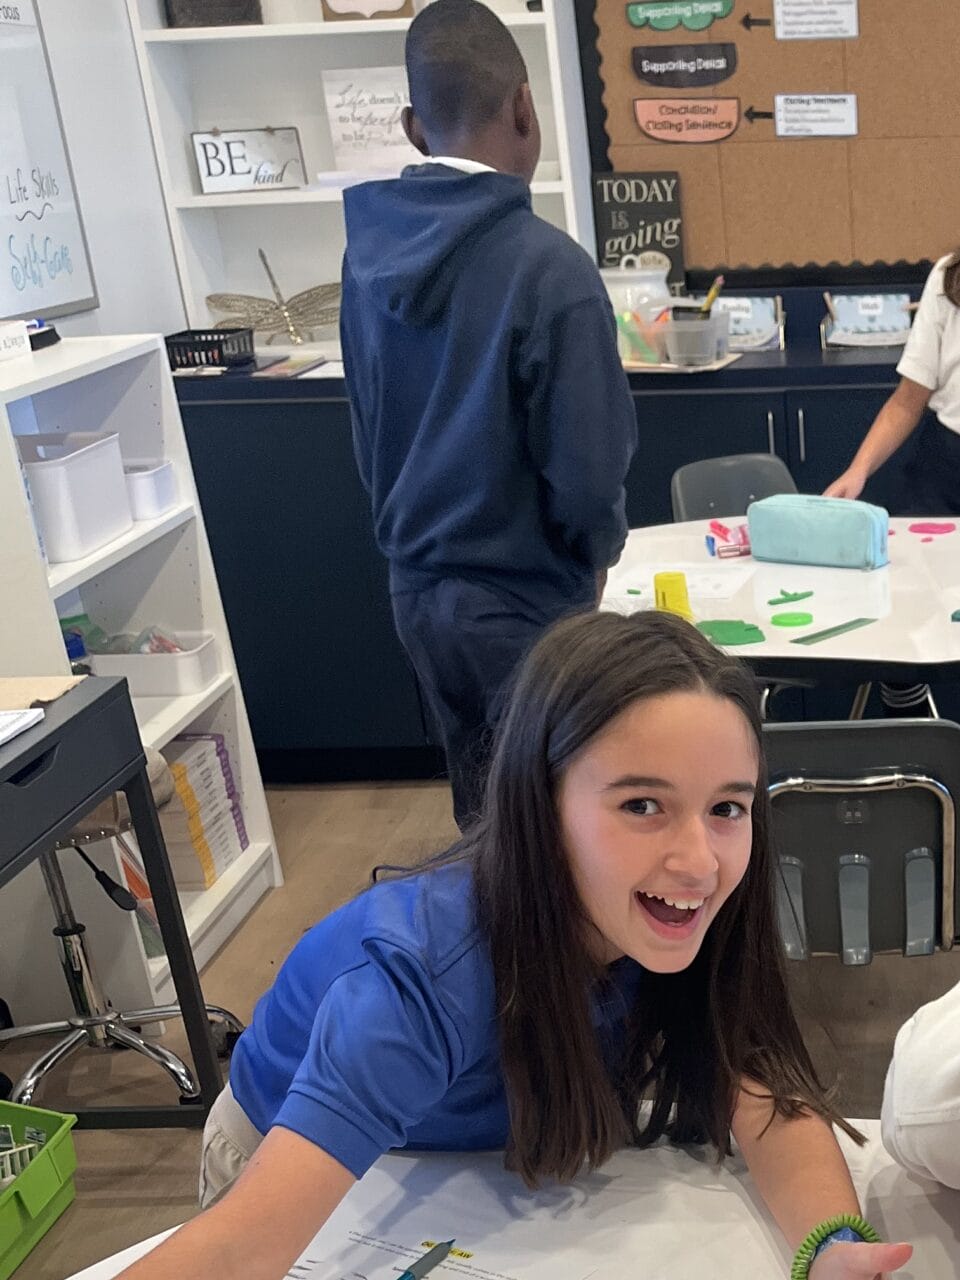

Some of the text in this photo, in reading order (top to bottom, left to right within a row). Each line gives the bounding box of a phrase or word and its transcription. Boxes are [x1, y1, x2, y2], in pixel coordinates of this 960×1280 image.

[0, 5, 20, 20] OCUS
[641, 60, 696, 73] Supporting
[200, 140, 252, 178] BE
[253, 159, 300, 185] kind
[596, 179, 677, 203] TODAY
[602, 217, 682, 267] going
